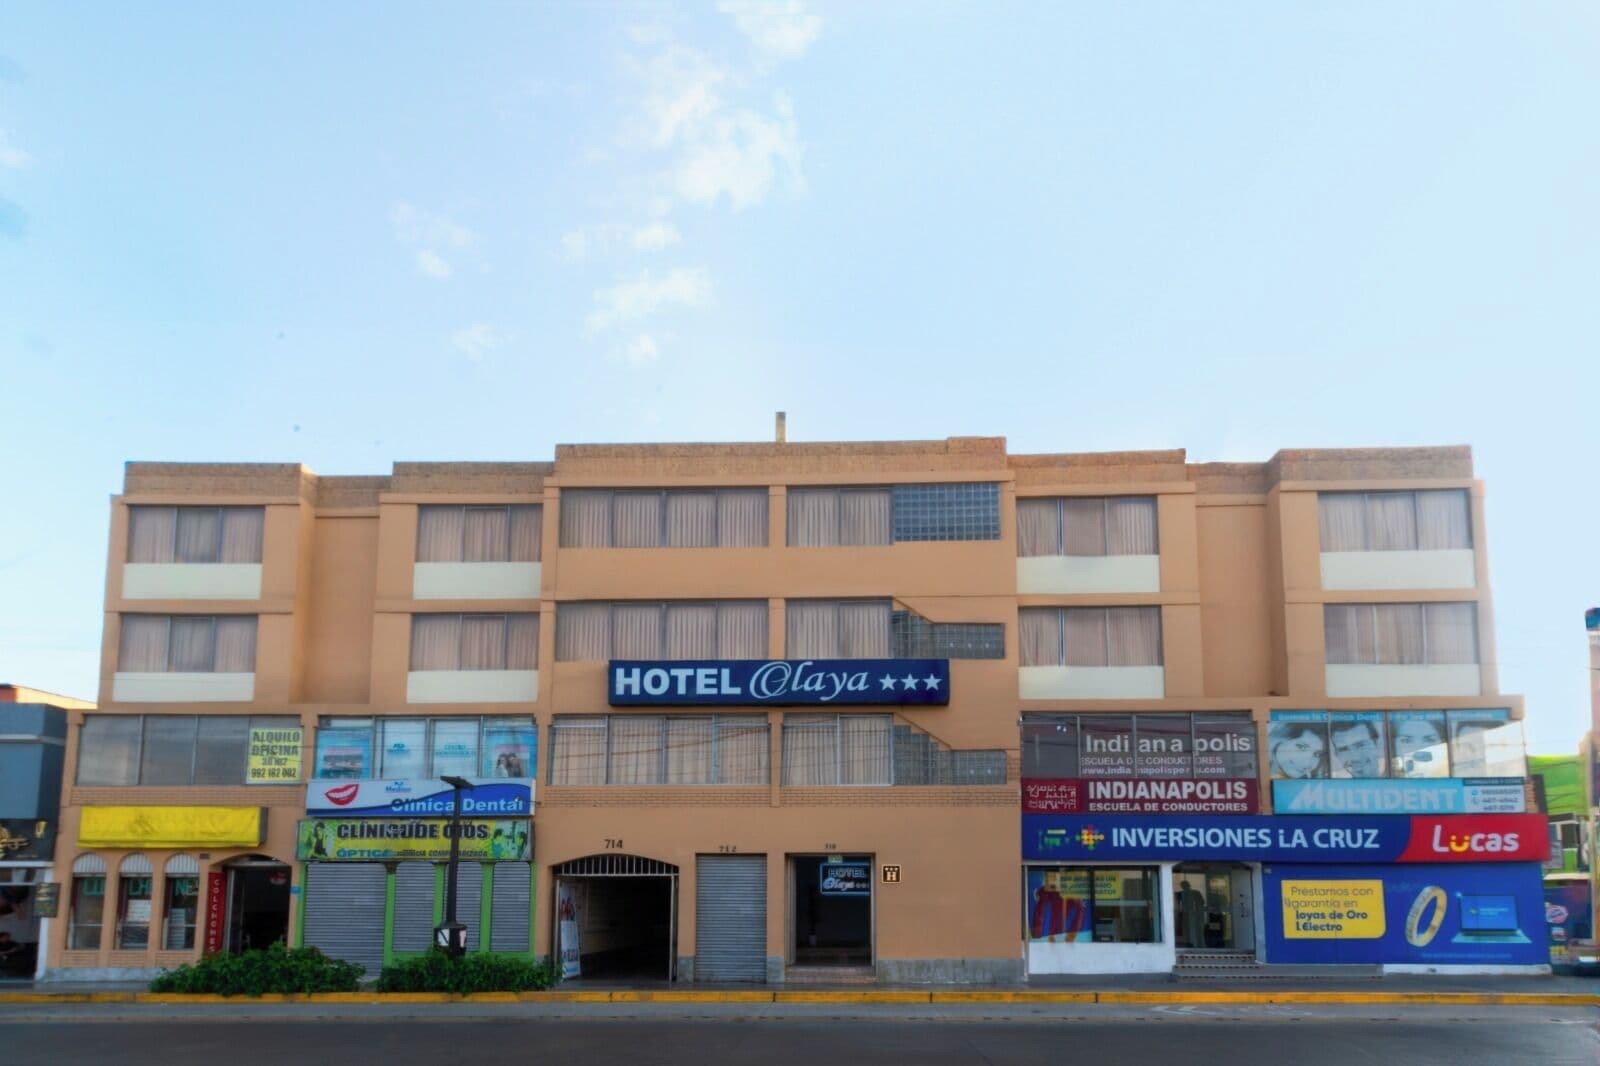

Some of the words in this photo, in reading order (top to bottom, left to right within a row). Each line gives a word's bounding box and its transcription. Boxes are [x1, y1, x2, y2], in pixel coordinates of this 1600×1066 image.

[615, 667, 742, 695] HOTEL
[749, 660, 869, 701] Olaya
[253, 731, 300, 743] ALQUILO
[252, 745, 298, 756] OFICINA
[1088, 781, 1248, 800] INDIANAPOLIS
[1288, 783, 1458, 811] MULTIDENT
[463, 797, 523, 812] Dental
[1088, 802, 1139, 812] ESCUELA
[1144, 802, 1159, 812] DE
[1163, 801, 1249, 812] CONDUCTORES
[604, 839, 623, 849] 714
[1112, 828, 1272, 849] INVERSIONES
[1313, 828, 1380, 848] CRUZ
[1432, 825, 1520, 853] Lucas
[1351, 888, 1373, 896] con
[1328, 911, 1344, 919] de
[1346, 910, 1368, 919] Oro
